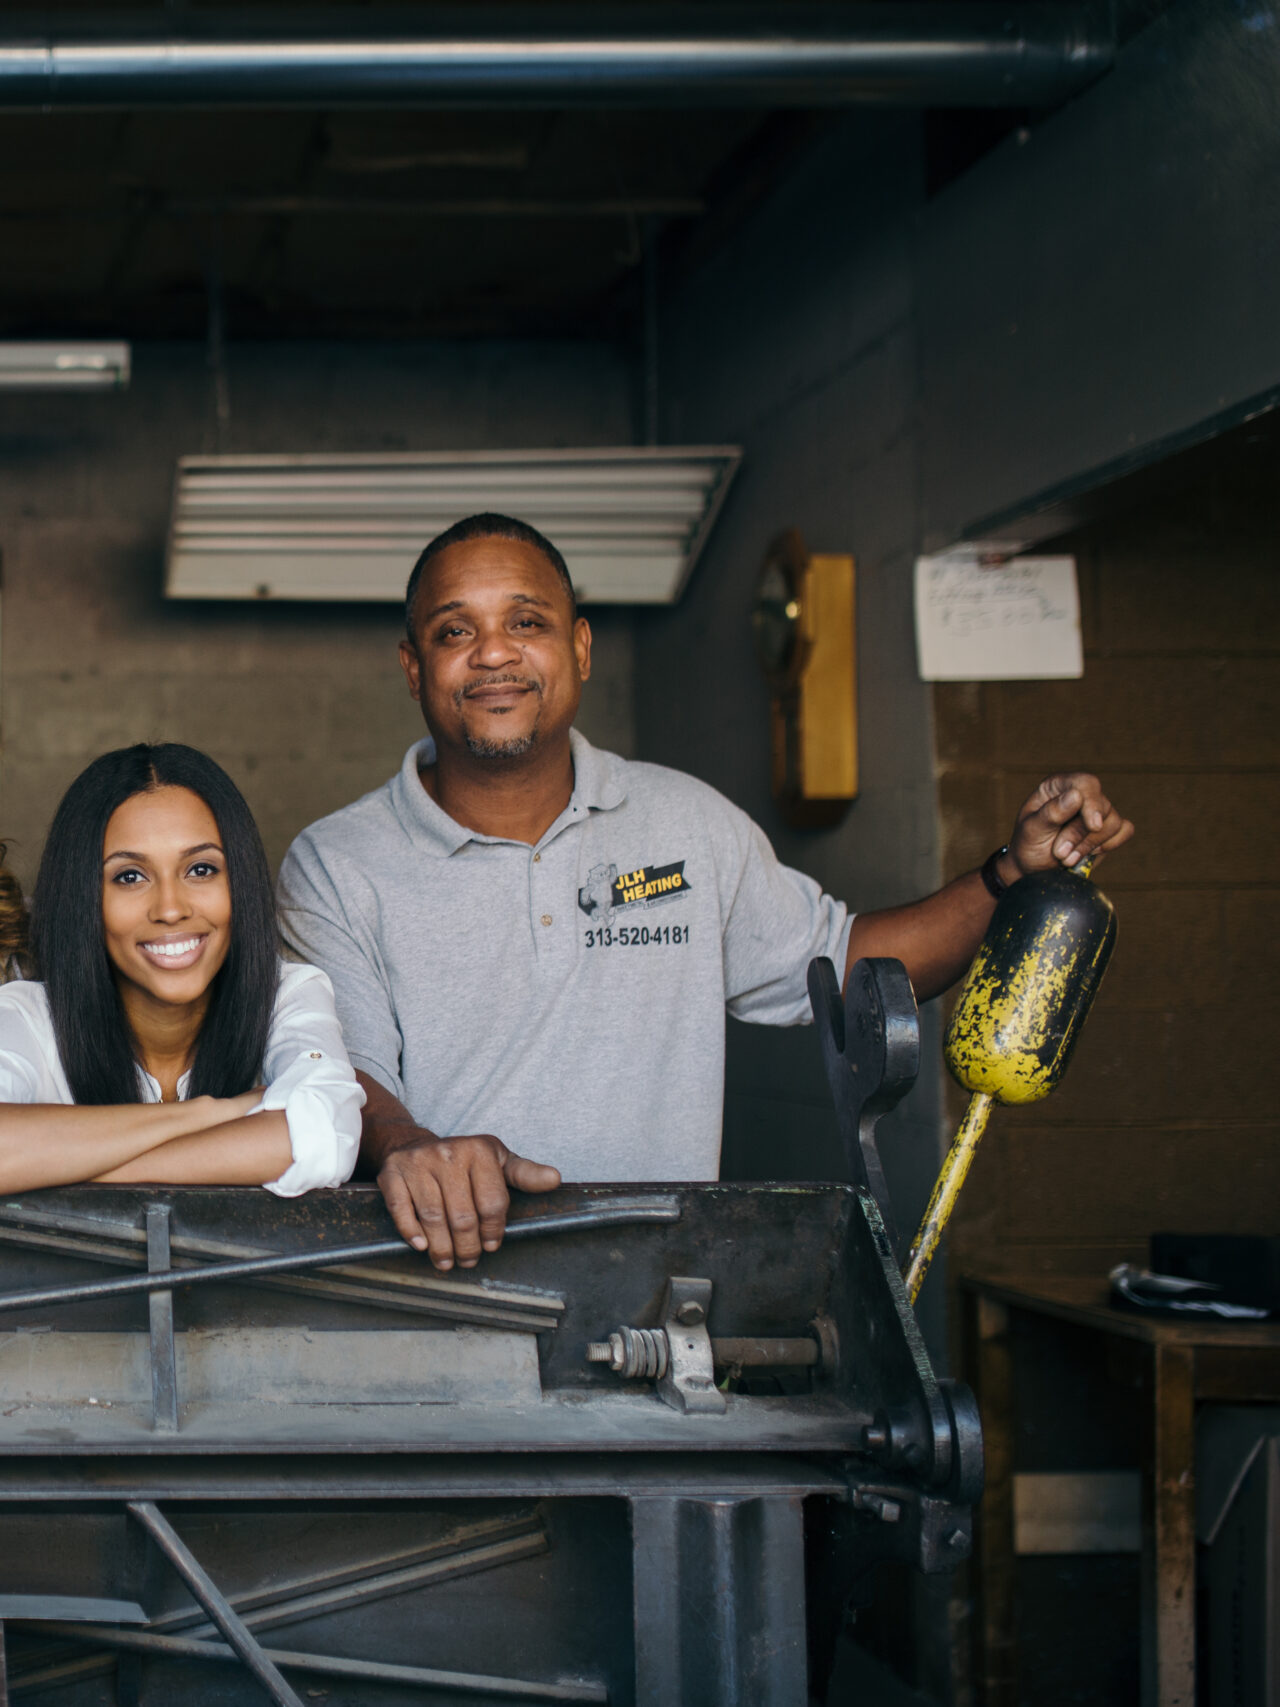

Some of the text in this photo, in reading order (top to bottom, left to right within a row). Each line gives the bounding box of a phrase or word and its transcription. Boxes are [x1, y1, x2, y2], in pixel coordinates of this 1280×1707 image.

[615, 868, 646, 890] JLH
[622, 873, 683, 903] HEATING
[585, 925, 689, 948] 313-520-4181
